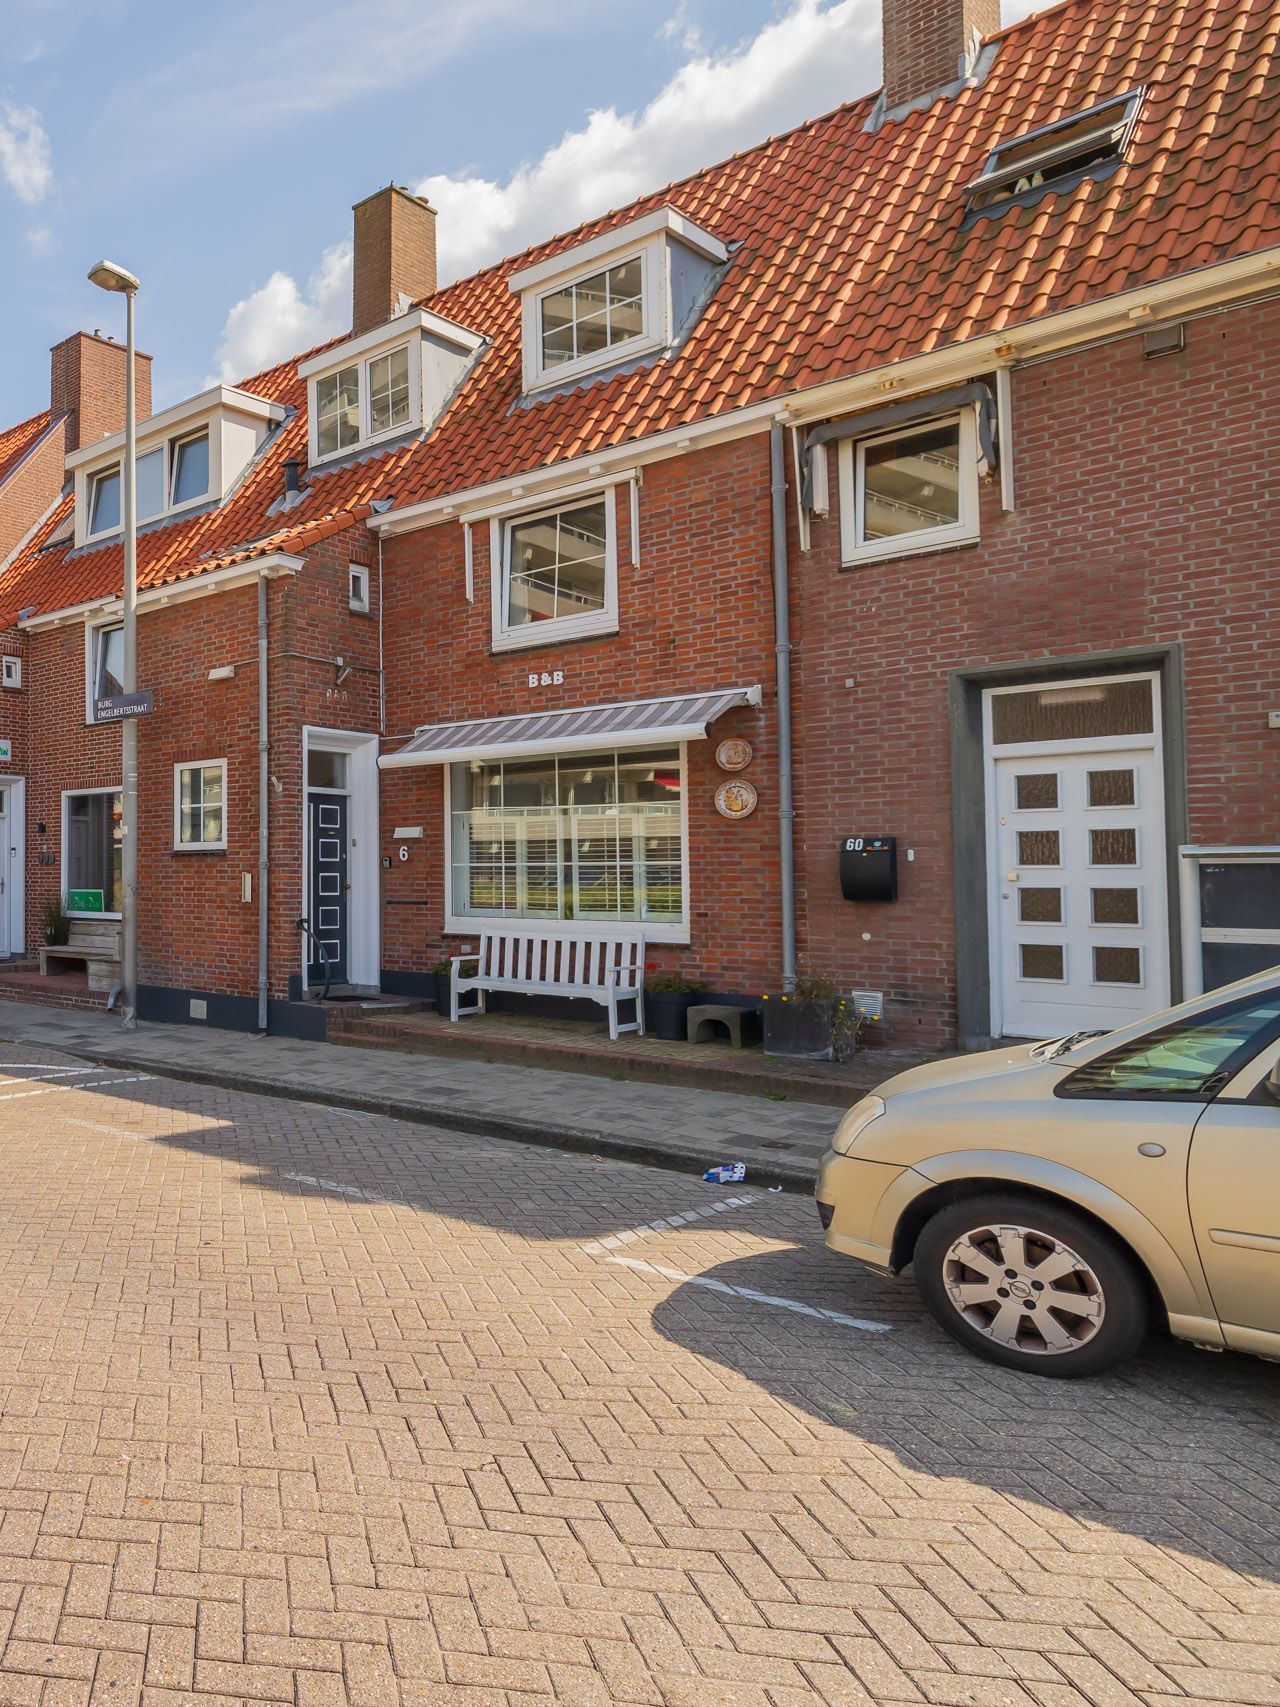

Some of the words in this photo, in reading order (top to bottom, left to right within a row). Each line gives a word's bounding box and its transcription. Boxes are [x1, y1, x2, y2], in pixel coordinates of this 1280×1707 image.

[528, 671, 564, 688] B&B
[97, 700, 113, 709] BURG
[97, 703, 148, 719] ENGELBERTSSTRAAT
[845, 838, 864, 851] 60
[399, 845, 409, 861] 6
